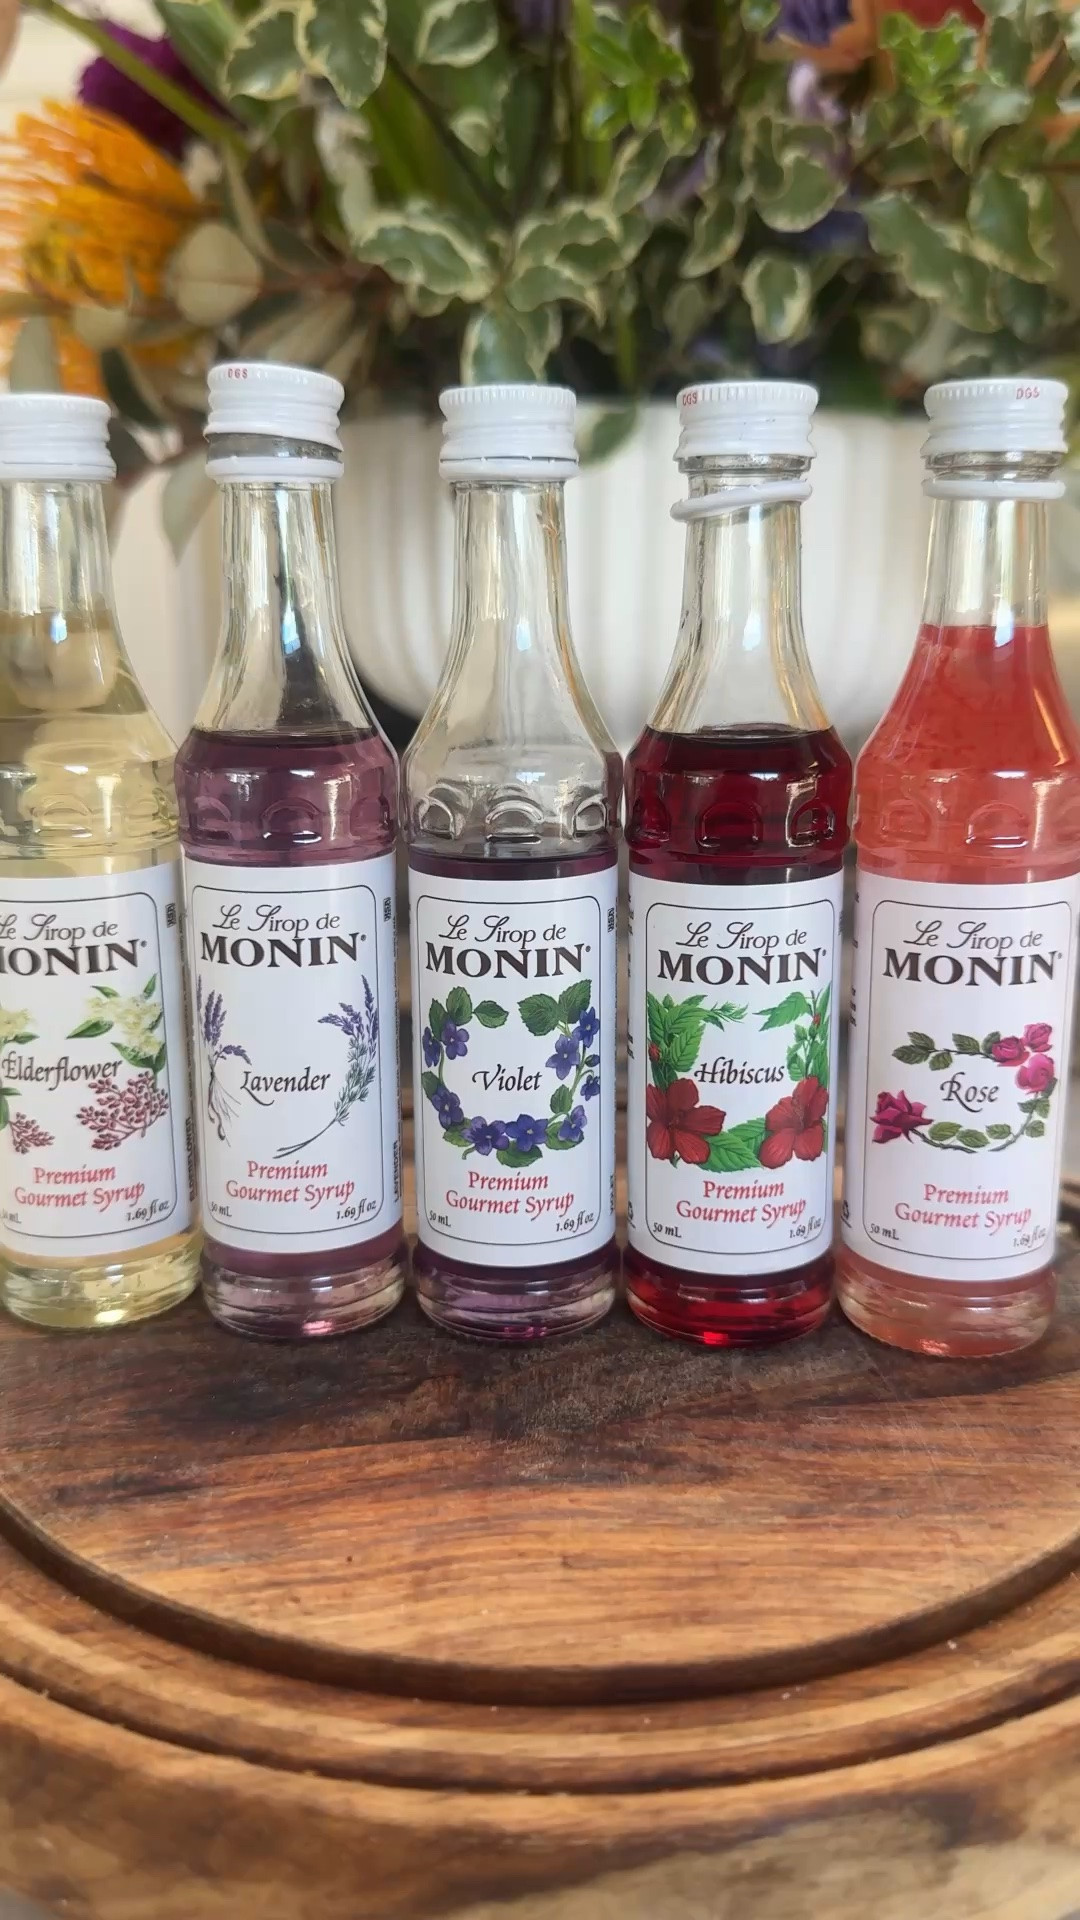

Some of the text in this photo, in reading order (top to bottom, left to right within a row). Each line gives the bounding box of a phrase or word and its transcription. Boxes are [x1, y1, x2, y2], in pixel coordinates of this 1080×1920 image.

[1016, 387, 1040, 400] DGS
[0, 913, 119, 947] Le Sirop de
[212, 904, 341, 938] Le Sirop de
[438, 914, 567, 949] Le Sirop de
[675, 921, 808, 955] Le Sirop de
[903, 919, 1044, 956] Le Sirop de
[2, 1050, 123, 1091] Elderflower
[471, 1063, 543, 1092] Violet
[693, 1056, 785, 1085] Hibiscus
[240, 1066, 331, 1106] Lavender
[939, 1071, 1000, 1113] Rose
[33, 1163, 117, 1185] Premium
[247, 1159, 329, 1180] Premium
[468, 1171, 549, 1191] Premium
[14, 1181, 146, 1212] Gourmet Syrup
[225, 1179, 356, 1210] Gourmet Syrup
[702, 1179, 785, 1199] Premium
[923, 1183, 1010, 1205] Premium
[126, 1209, 150, 1222] 1.69
[210, 1201, 233, 1217] 50 mL
[336, 1207, 356, 1220] 1.69
[429, 1210, 452, 1227] 50 mL
[445, 1189, 575, 1222] Gourmet Syrup
[676, 1198, 807, 1229] Gourmet Syrup
[894, 1202, 1032, 1236] Gourmet Syrup
[555, 1218, 575, 1232] 1.69
[652, 1222, 682, 1238] 50 mL
[869, 1223, 900, 1240] 50 mL
